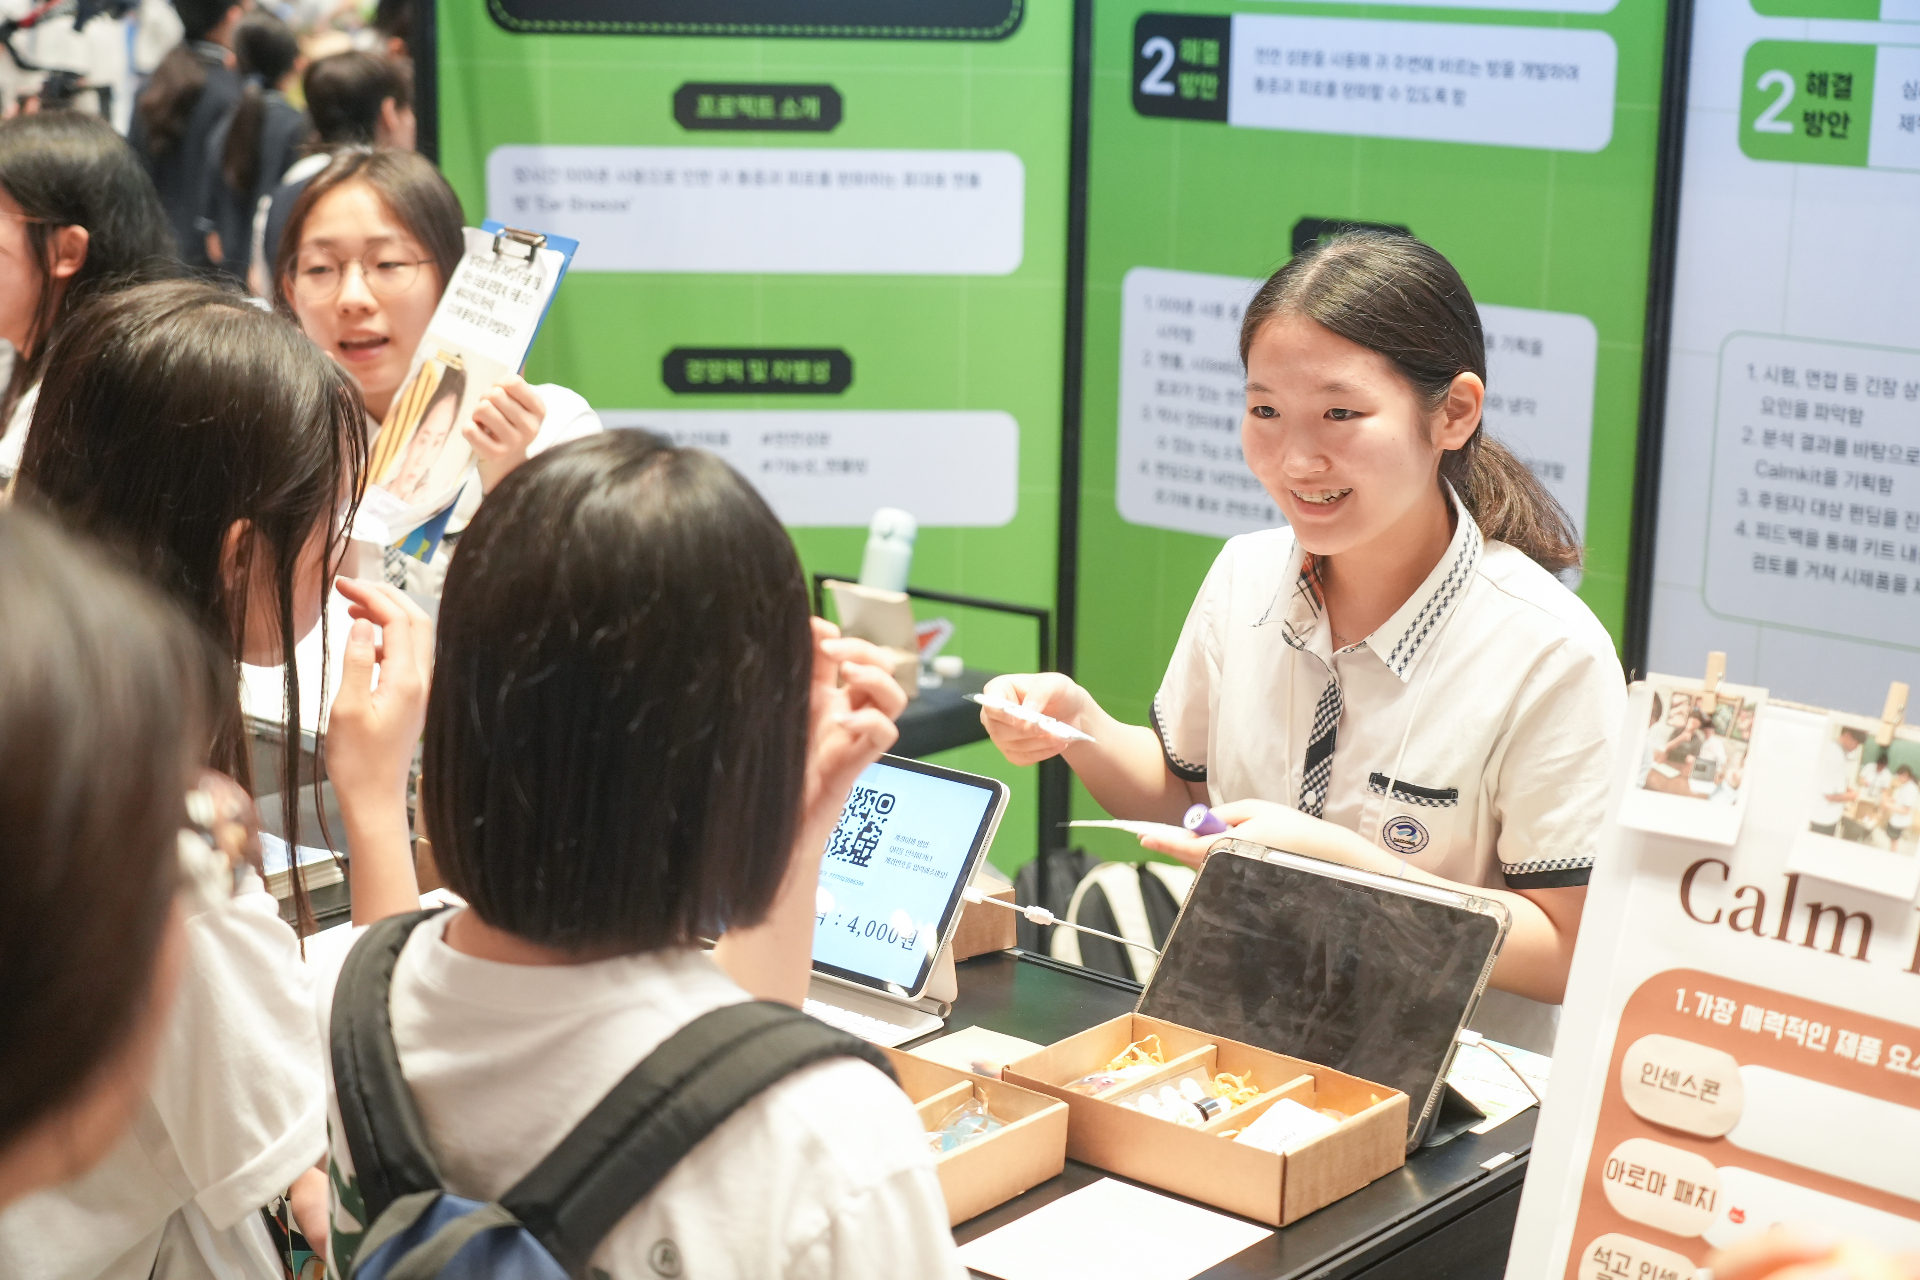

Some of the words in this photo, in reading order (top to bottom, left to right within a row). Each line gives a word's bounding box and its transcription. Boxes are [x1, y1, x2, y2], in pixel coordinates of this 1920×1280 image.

[1140, 35, 1175, 97] 2
[1179, 37, 1220, 67] 해결
[1178, 71, 1220, 101] 방안
[1753, 69, 1796, 134] 2
[1806, 71, 1853, 102] 해결
[695, 94, 776, 121] 프로젝트
[780, 94, 821, 121] 소개
[1803, 109, 1851, 139] 방안
[1746, 363, 1758, 382] 1.
[1764, 365, 1800, 388] 시험,
[1805, 368, 1838, 391] 면접
[1843, 372, 1859, 395] 등
[1866, 375, 1898, 399] 긴장
[1760, 395, 1809, 420] 요인을
[1813, 402, 1864, 428] 파악함
[1741, 425, 1757, 445] 2.
[1762, 428, 1795, 449] 분석
[1800, 432, 1848, 457] 결과를
[1852, 438, 1920, 465] 바탕으로
[1755, 459, 1838, 490] Calmkit을
[1844, 470, 1894, 498] 기획함
[1736, 487, 1752, 508] 3.
[1758, 490, 1806, 515] 후원자
[1811, 497, 1844, 522] 대상
[1849, 502, 1898, 528] 펀딩을
[1734, 519, 1750, 539] 4.
[1755, 521, 1820, 550] 피드백을
[1825, 530, 1858, 556] 통해
[1862, 536, 1896, 560] 키트
[1900, 541, 1920, 564] 내
[1753, 551, 1799, 579] 검토를
[1805, 559, 1837, 584] 거쳐
[1841, 567, 1907, 596] 시제품을
[1680, 857, 1874, 963] Calm
[1675, 987, 1690, 1014] 1.
[1694, 990, 1737, 1027] 가장
[1739, 1003, 1831, 1052] 매력적인
[1833, 1028, 1883, 1067] 제품
[1639, 1060, 1722, 1106] 인센스콘
[1605, 1156, 1668, 1198] 아로마
[1672, 1177, 1719, 1214] 패치
[1593, 1245, 1633, 1278] 석고
